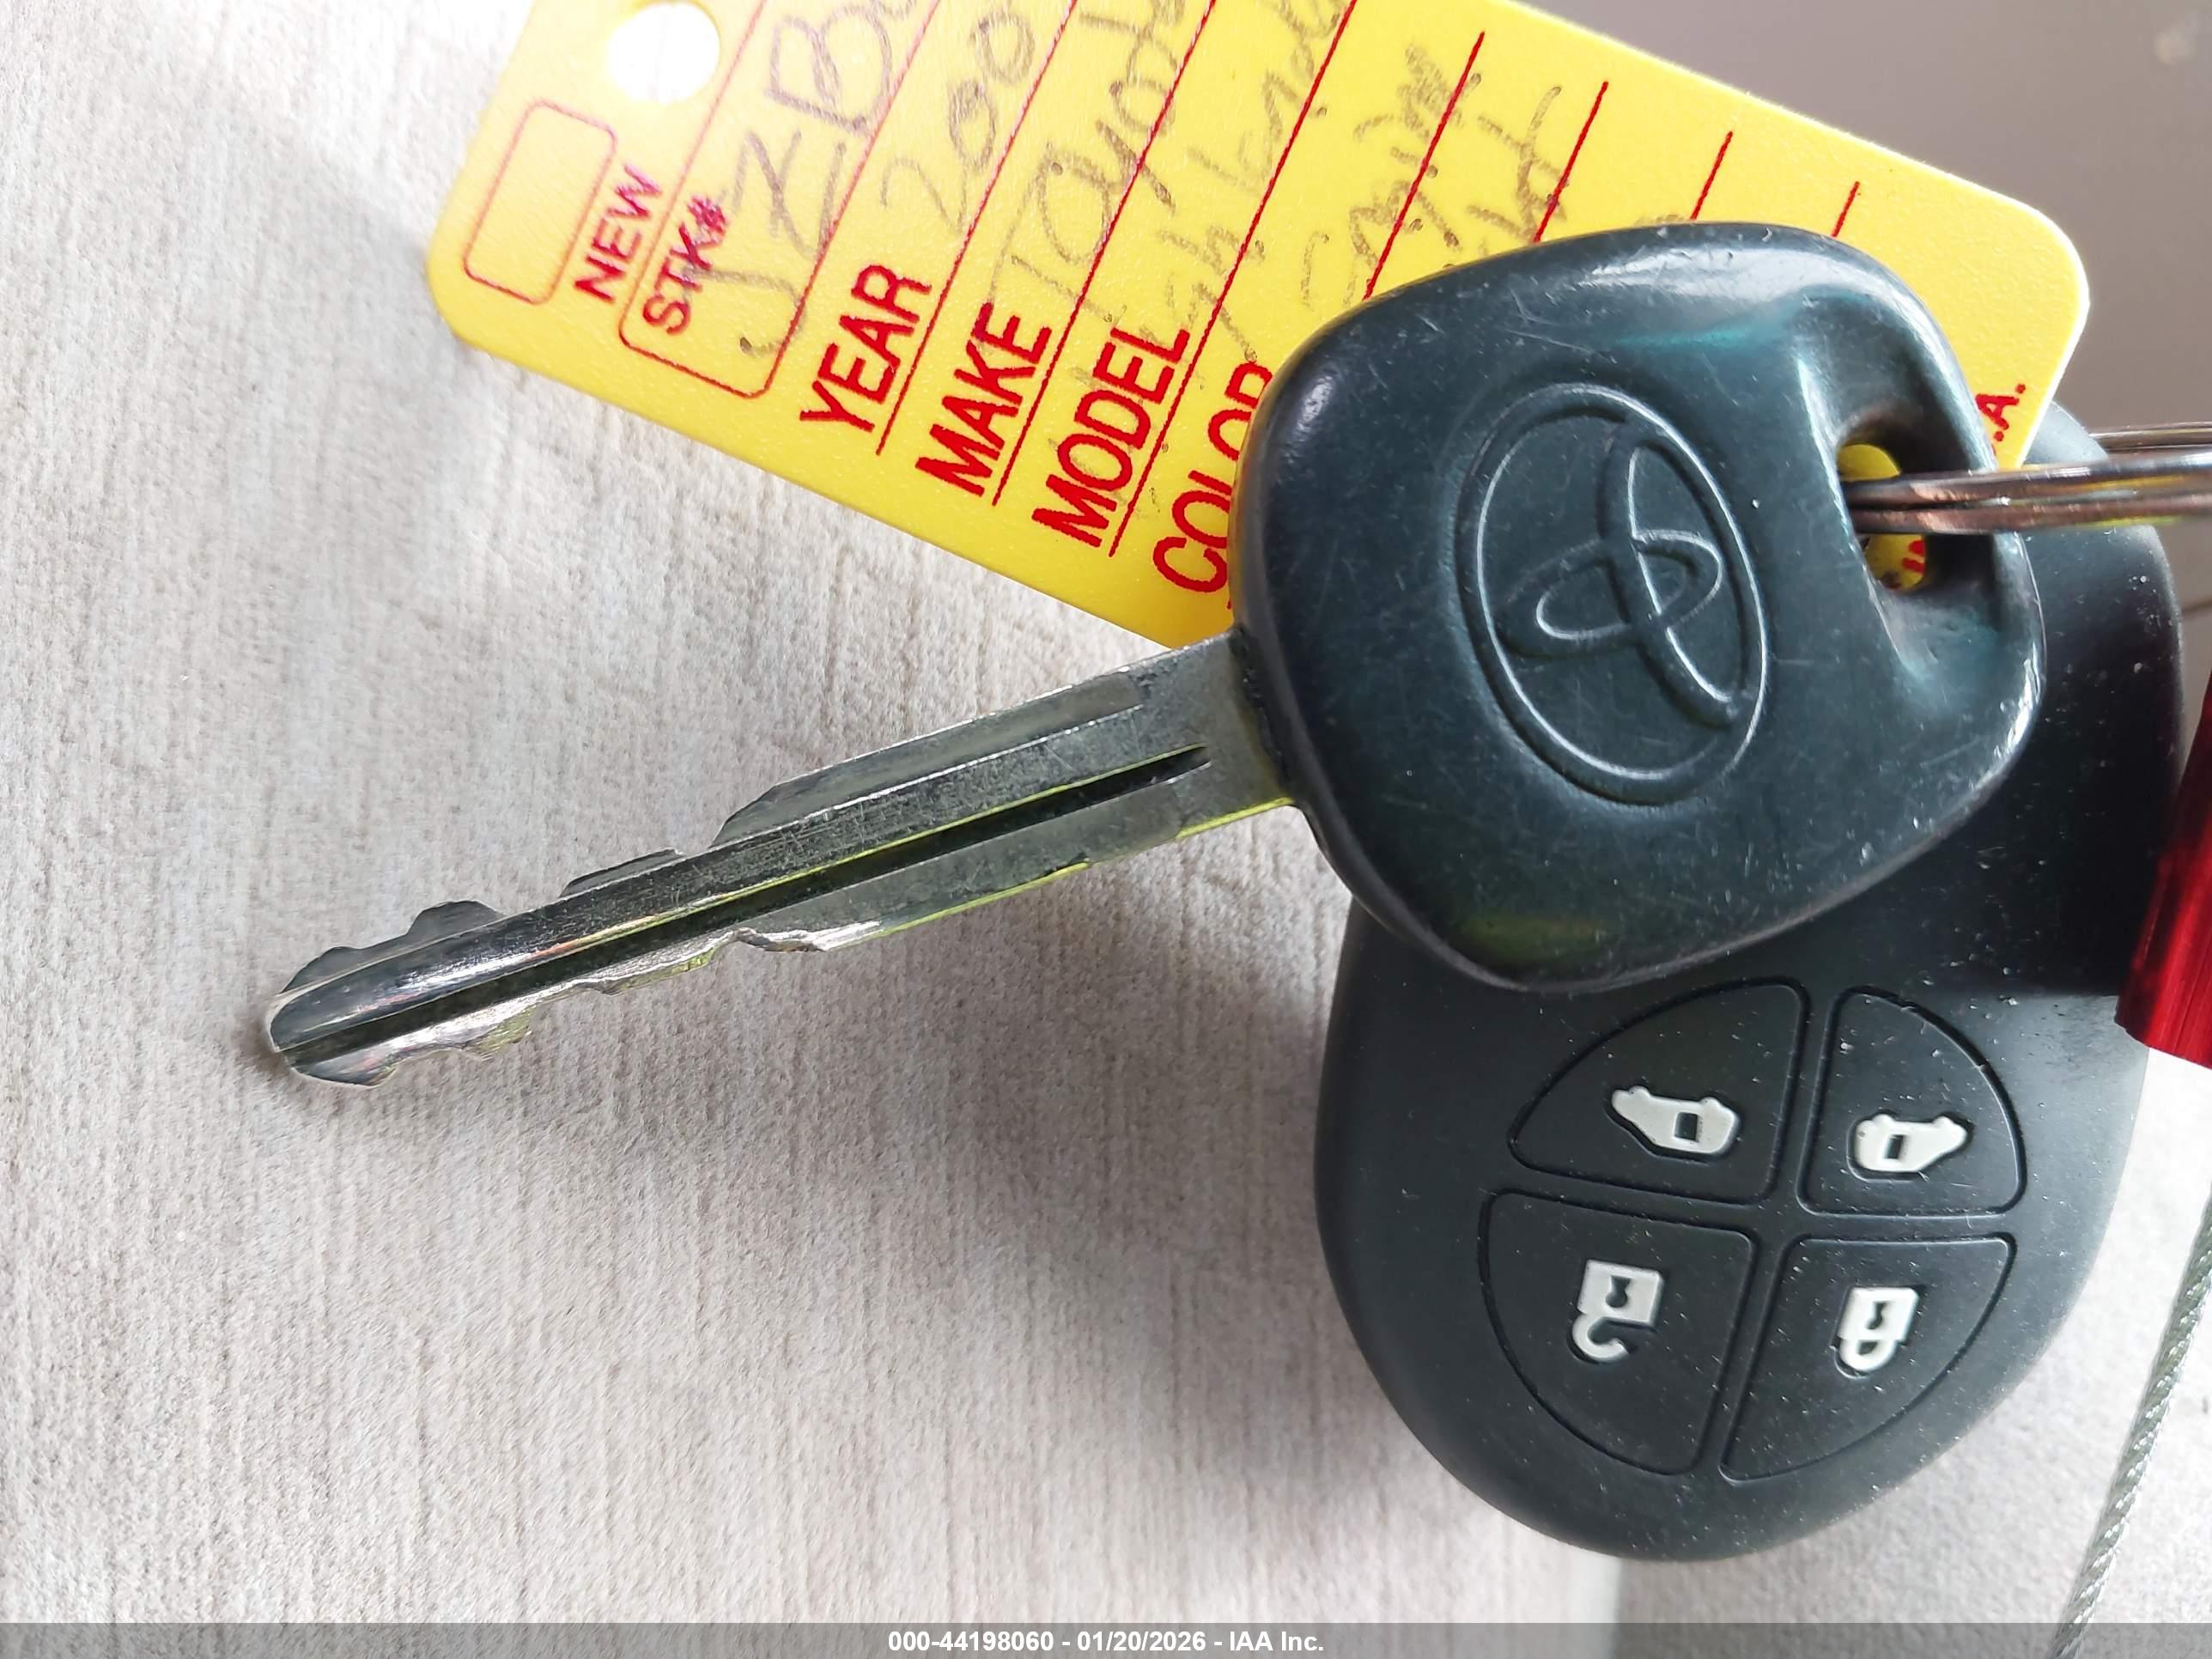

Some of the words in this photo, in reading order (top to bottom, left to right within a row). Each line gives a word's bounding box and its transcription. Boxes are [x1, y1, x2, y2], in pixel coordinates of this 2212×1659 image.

[574, 163, 662, 302] NEW
[642, 193, 728, 335] STK#
[799, 264, 932, 433] YEAR
[915, 302, 1052, 497] MAKE
[1031, 327, 1190, 548] MODEL
